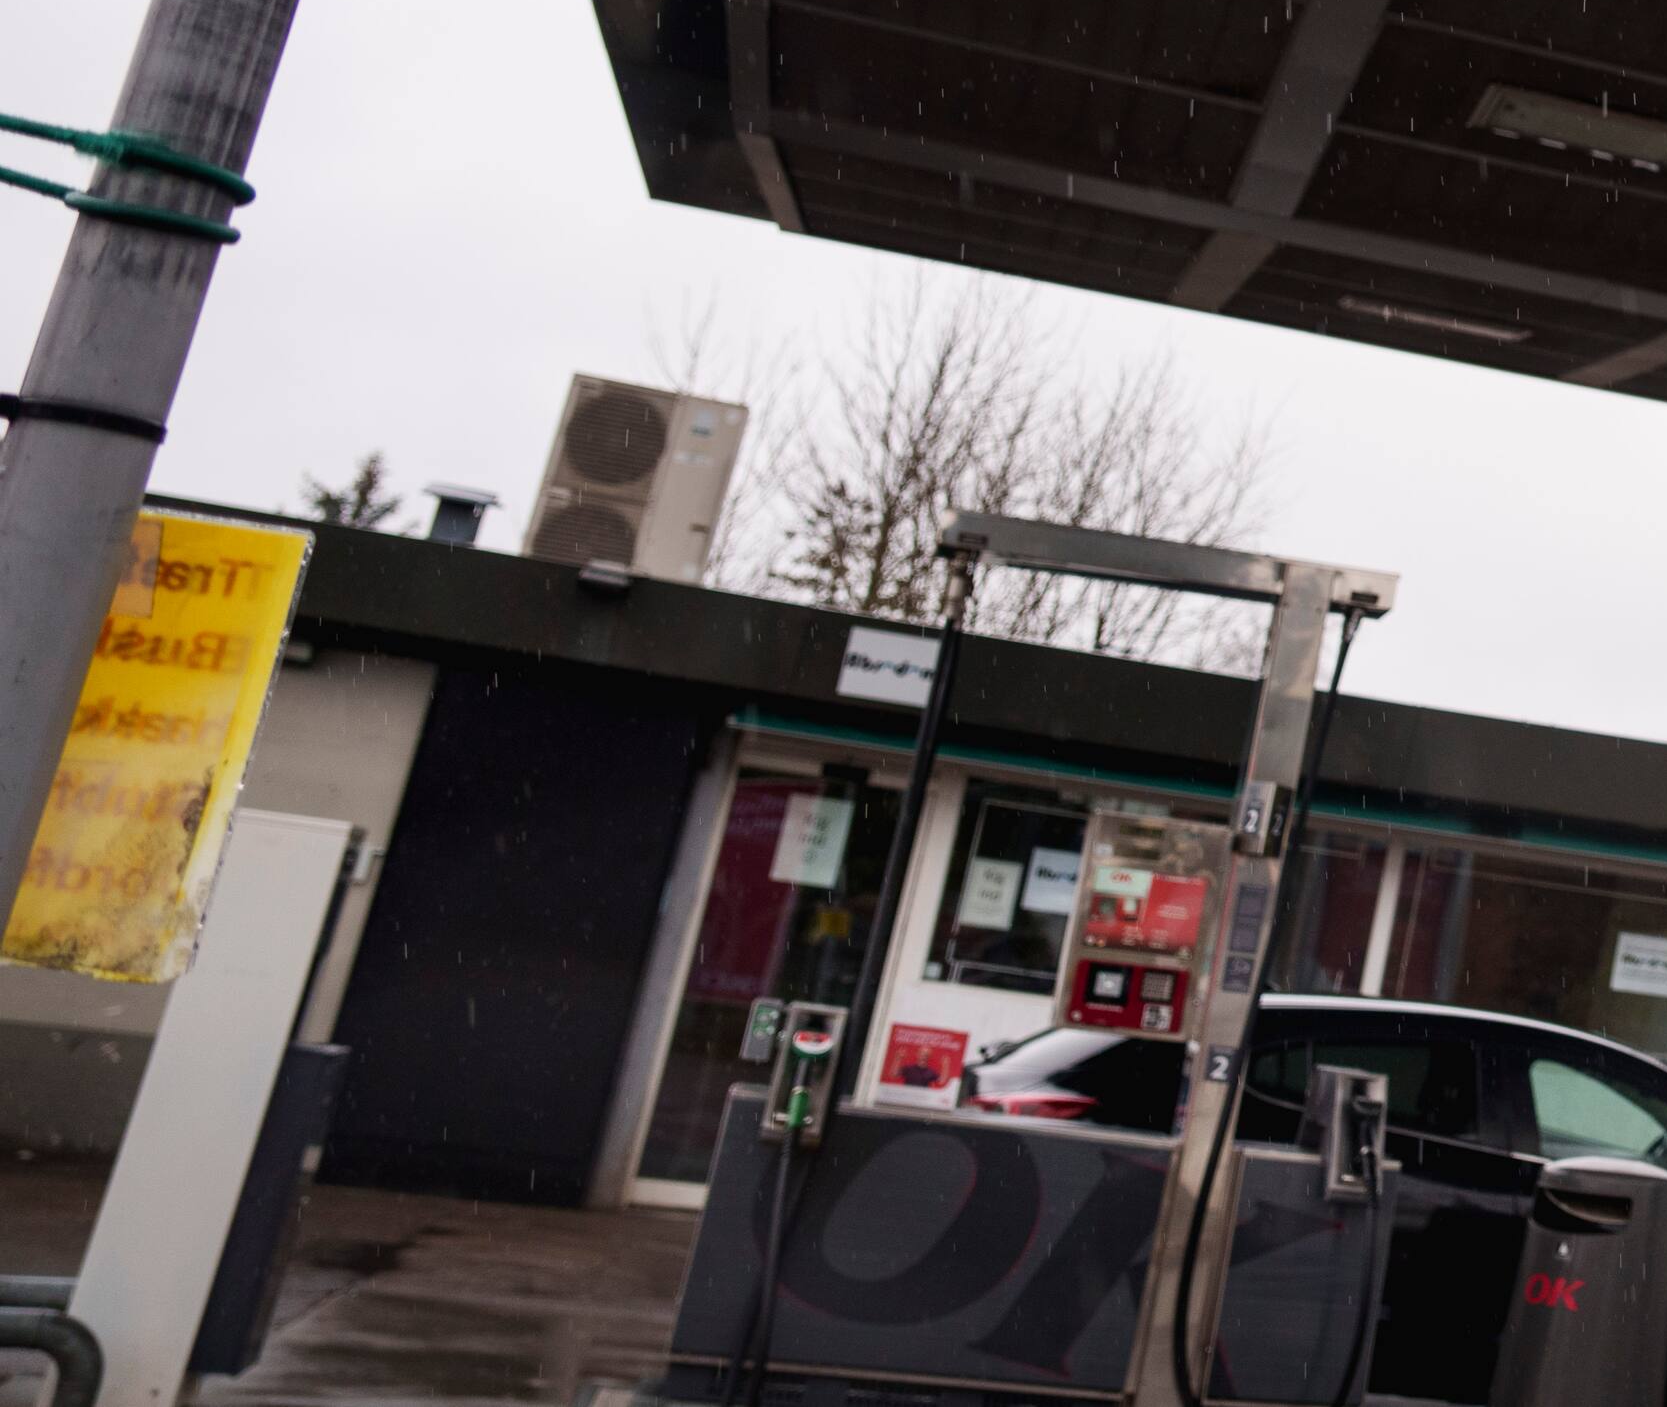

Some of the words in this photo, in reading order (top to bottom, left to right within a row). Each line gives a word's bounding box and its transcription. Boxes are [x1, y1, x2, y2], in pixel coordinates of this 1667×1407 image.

[1244, 809, 1260, 833] 2
[1209, 1055, 1230, 1080] 2
[1523, 1272, 1585, 1312] OK
